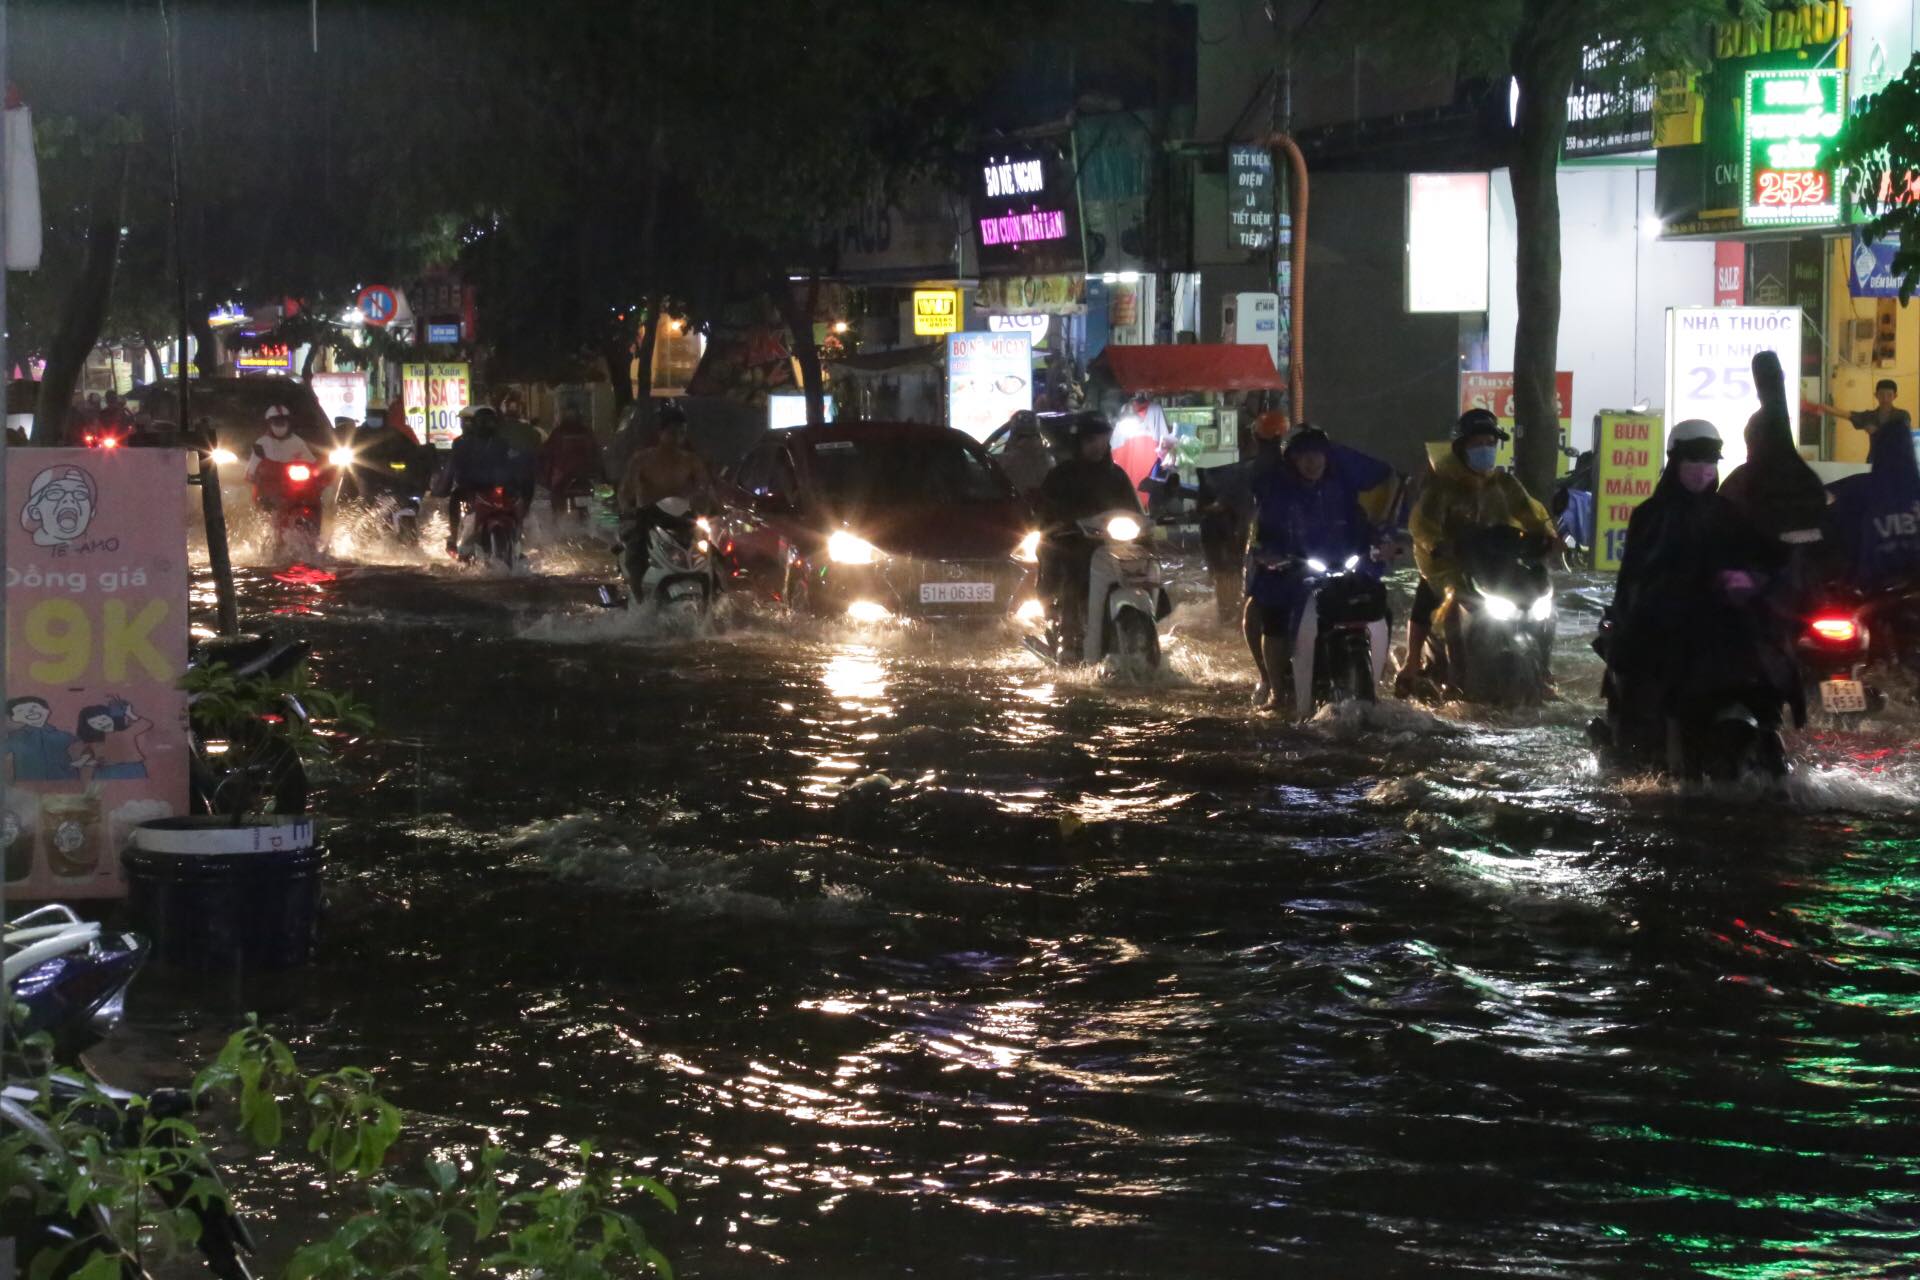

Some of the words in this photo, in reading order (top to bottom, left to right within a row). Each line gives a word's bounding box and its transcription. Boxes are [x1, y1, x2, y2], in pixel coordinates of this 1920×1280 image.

[1758, 172, 1823, 203] 252
[1718, 267, 1739, 291] SALE
[1683, 312, 1720, 330] NHÀ
[1729, 309, 1791, 331] THUỐC
[404, 379, 467, 406] MASAGE
[98, 566, 147, 593] giá
[922, 586, 946, 601] 51H
[6, 597, 176, 684] 9K
